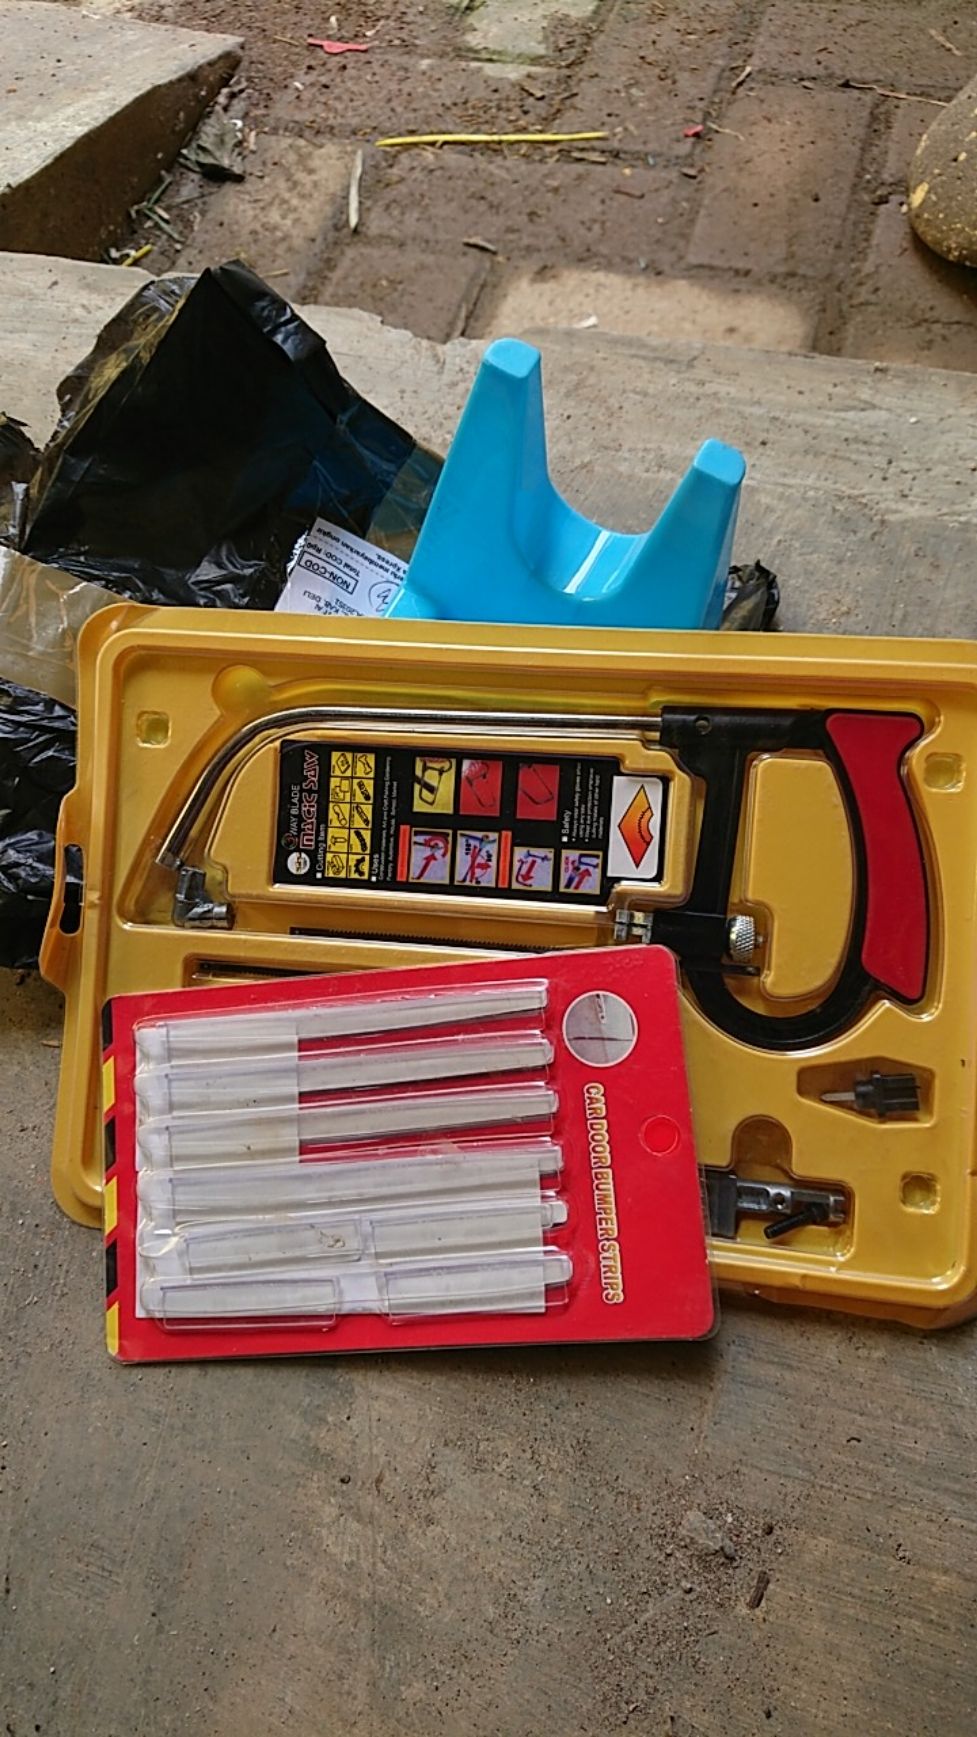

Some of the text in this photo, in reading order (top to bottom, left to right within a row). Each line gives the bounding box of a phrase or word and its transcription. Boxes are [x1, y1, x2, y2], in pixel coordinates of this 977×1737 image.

[316, 527, 340, 544] ongkir
[304, 558, 351, 590] NON-COD
[343, 564, 360, 577] Total
[302, 749, 320, 790] SAW
[291, 784, 300, 815] BLADE
[562, 810, 572, 834] Safety
[315, 843, 325, 871] Cutting
[583, 1082, 624, 1304] CAR DOOR BUMPER STRIPS
